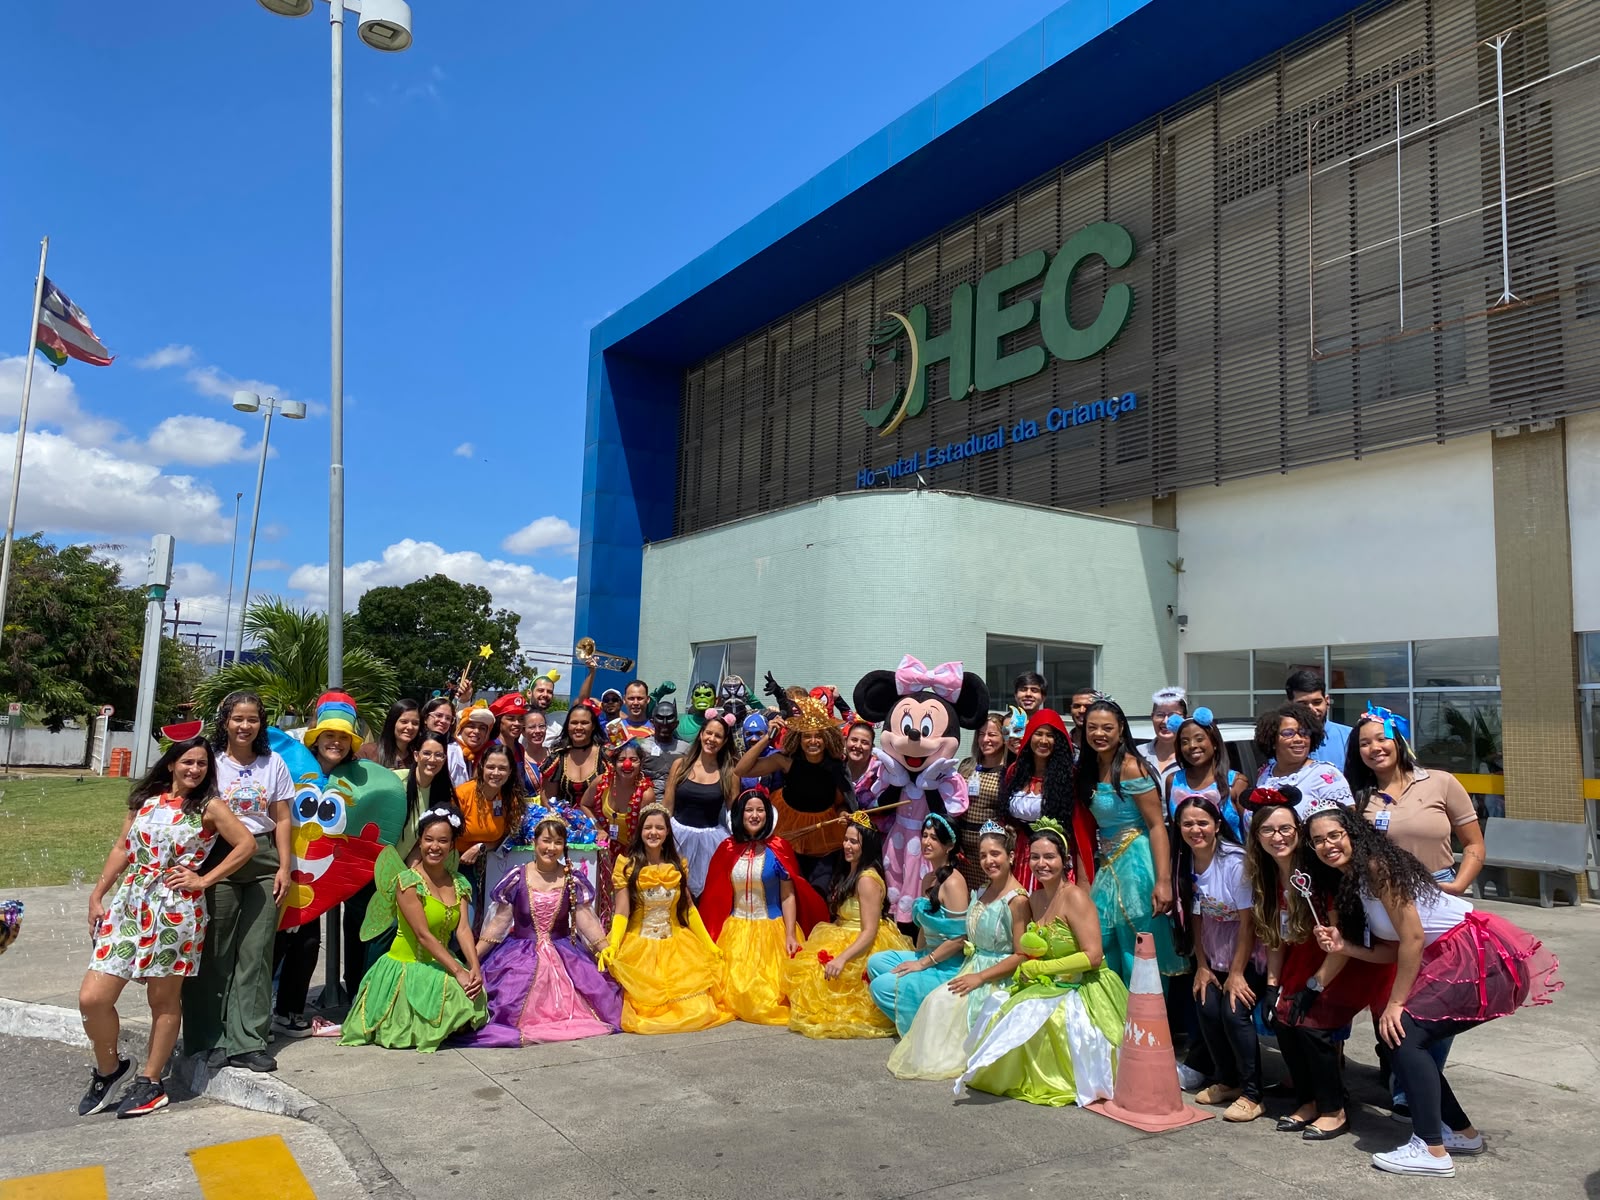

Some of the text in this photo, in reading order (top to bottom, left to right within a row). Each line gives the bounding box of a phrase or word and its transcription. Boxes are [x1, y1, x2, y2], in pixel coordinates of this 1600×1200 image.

[906, 220, 1134, 417] HEC
[925, 426, 1005, 468] Estadual
[1012, 418, 1039, 443] da
[1046, 391, 1137, 431] Criança
[749, 720, 758, 728] A
